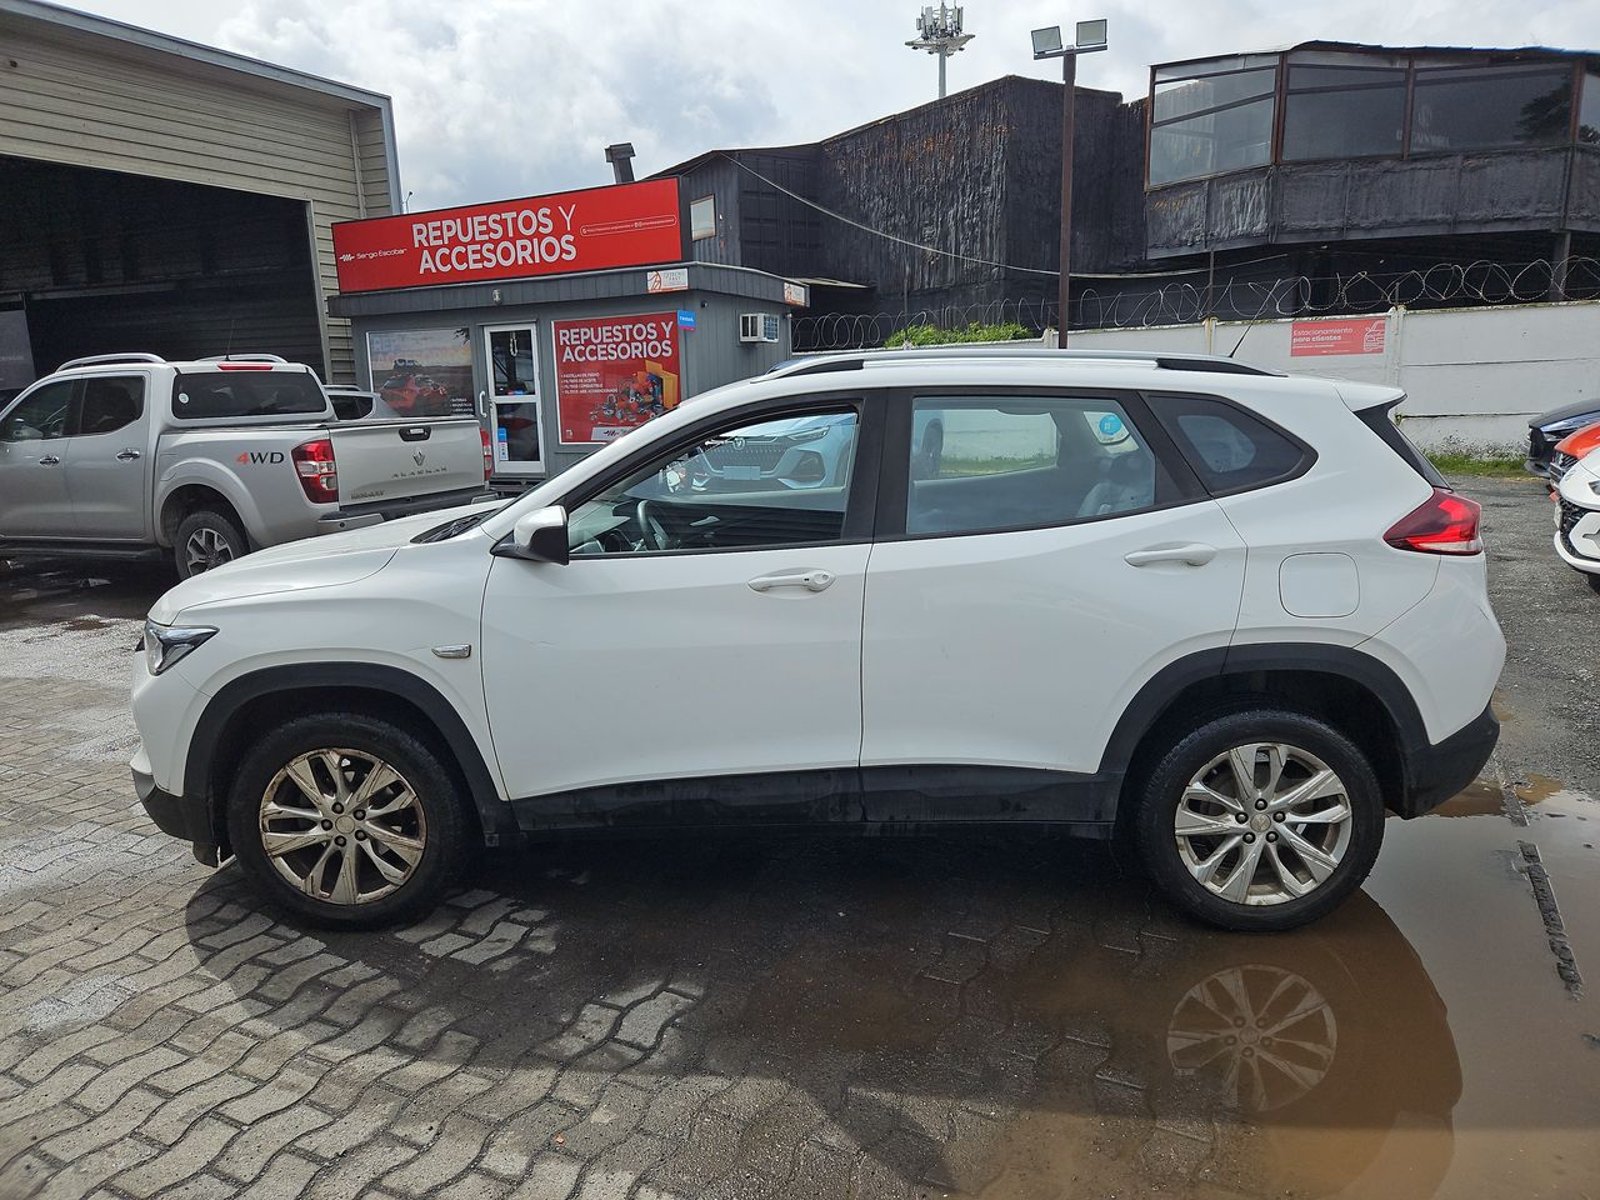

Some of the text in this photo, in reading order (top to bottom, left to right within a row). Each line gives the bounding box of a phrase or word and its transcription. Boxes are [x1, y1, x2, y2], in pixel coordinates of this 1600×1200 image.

[412, 207, 552, 248] REPUESTOS
[558, 204, 577, 232] Y
[379, 248, 408, 257] Escobar
[419, 234, 578, 275] ACCESORIOS
[559, 321, 674, 346] REPUESTOS Y
[1293, 327, 1353, 336] Estacionamiento
[1293, 336, 1311, 344] para
[562, 340, 673, 363] ACCESORIOS
[236, 450, 285, 465] 4WD
